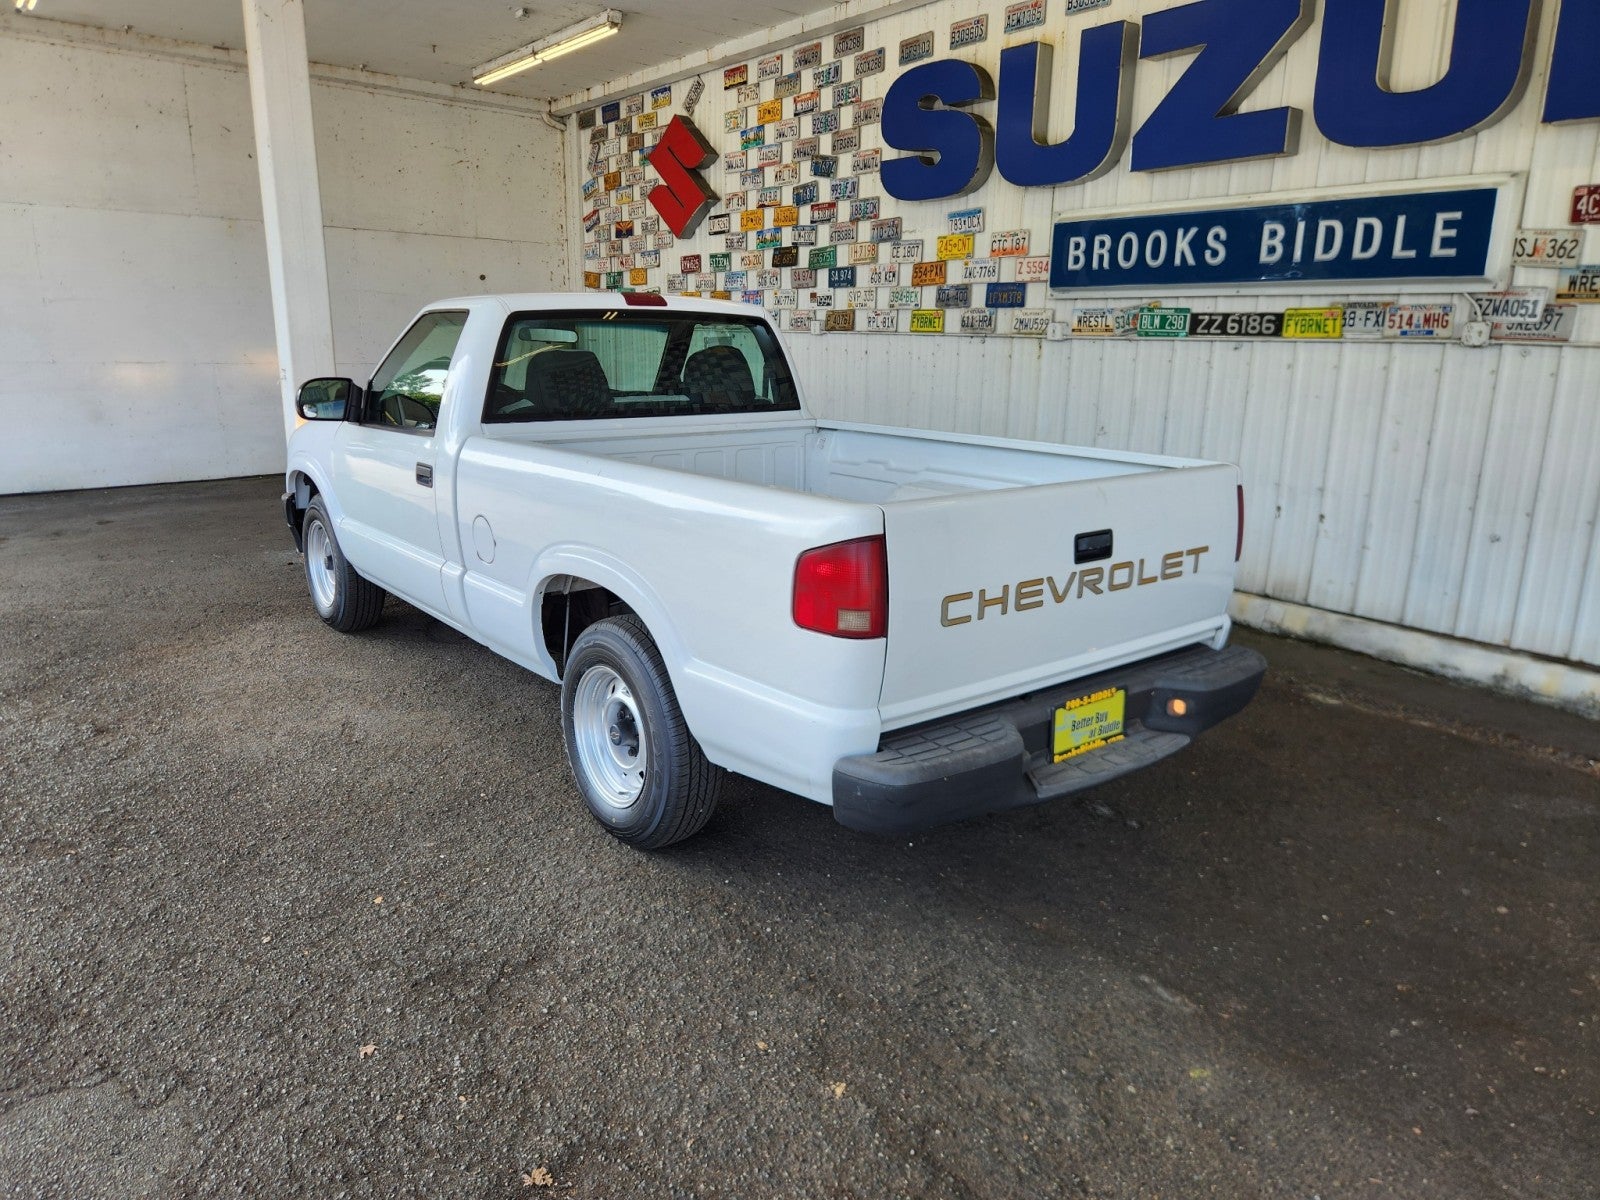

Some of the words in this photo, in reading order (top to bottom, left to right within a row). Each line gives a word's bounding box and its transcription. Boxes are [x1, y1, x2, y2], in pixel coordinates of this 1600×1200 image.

[949, 219, 963, 231] 783
[939, 240, 953, 253] 245
[1011, 238, 1026, 251] 187
[1066, 224, 1227, 272] BROOKS
[1258, 211, 1463, 265] BIDDLE
[1546, 238, 1579, 259] 362
[892, 246, 900, 259] CE
[1018, 262, 1024, 275] Z
[911, 315, 942, 329] FYBRNET
[1077, 314, 1111, 329] WRESTL
[1164, 315, 1185, 330] 298
[1196, 314, 1224, 335] ZZ
[1226, 313, 1277, 335] 6186
[1284, 317, 1339, 334] FYBRNET
[1388, 313, 1414, 330] 514
[1422, 313, 1450, 330] MHG
[940, 545, 1209, 628] CHEVROLET
[1071, 715, 1095, 732] Better
[1095, 711, 1109, 724] Buy
[1098, 720, 1121, 736] Biddle
